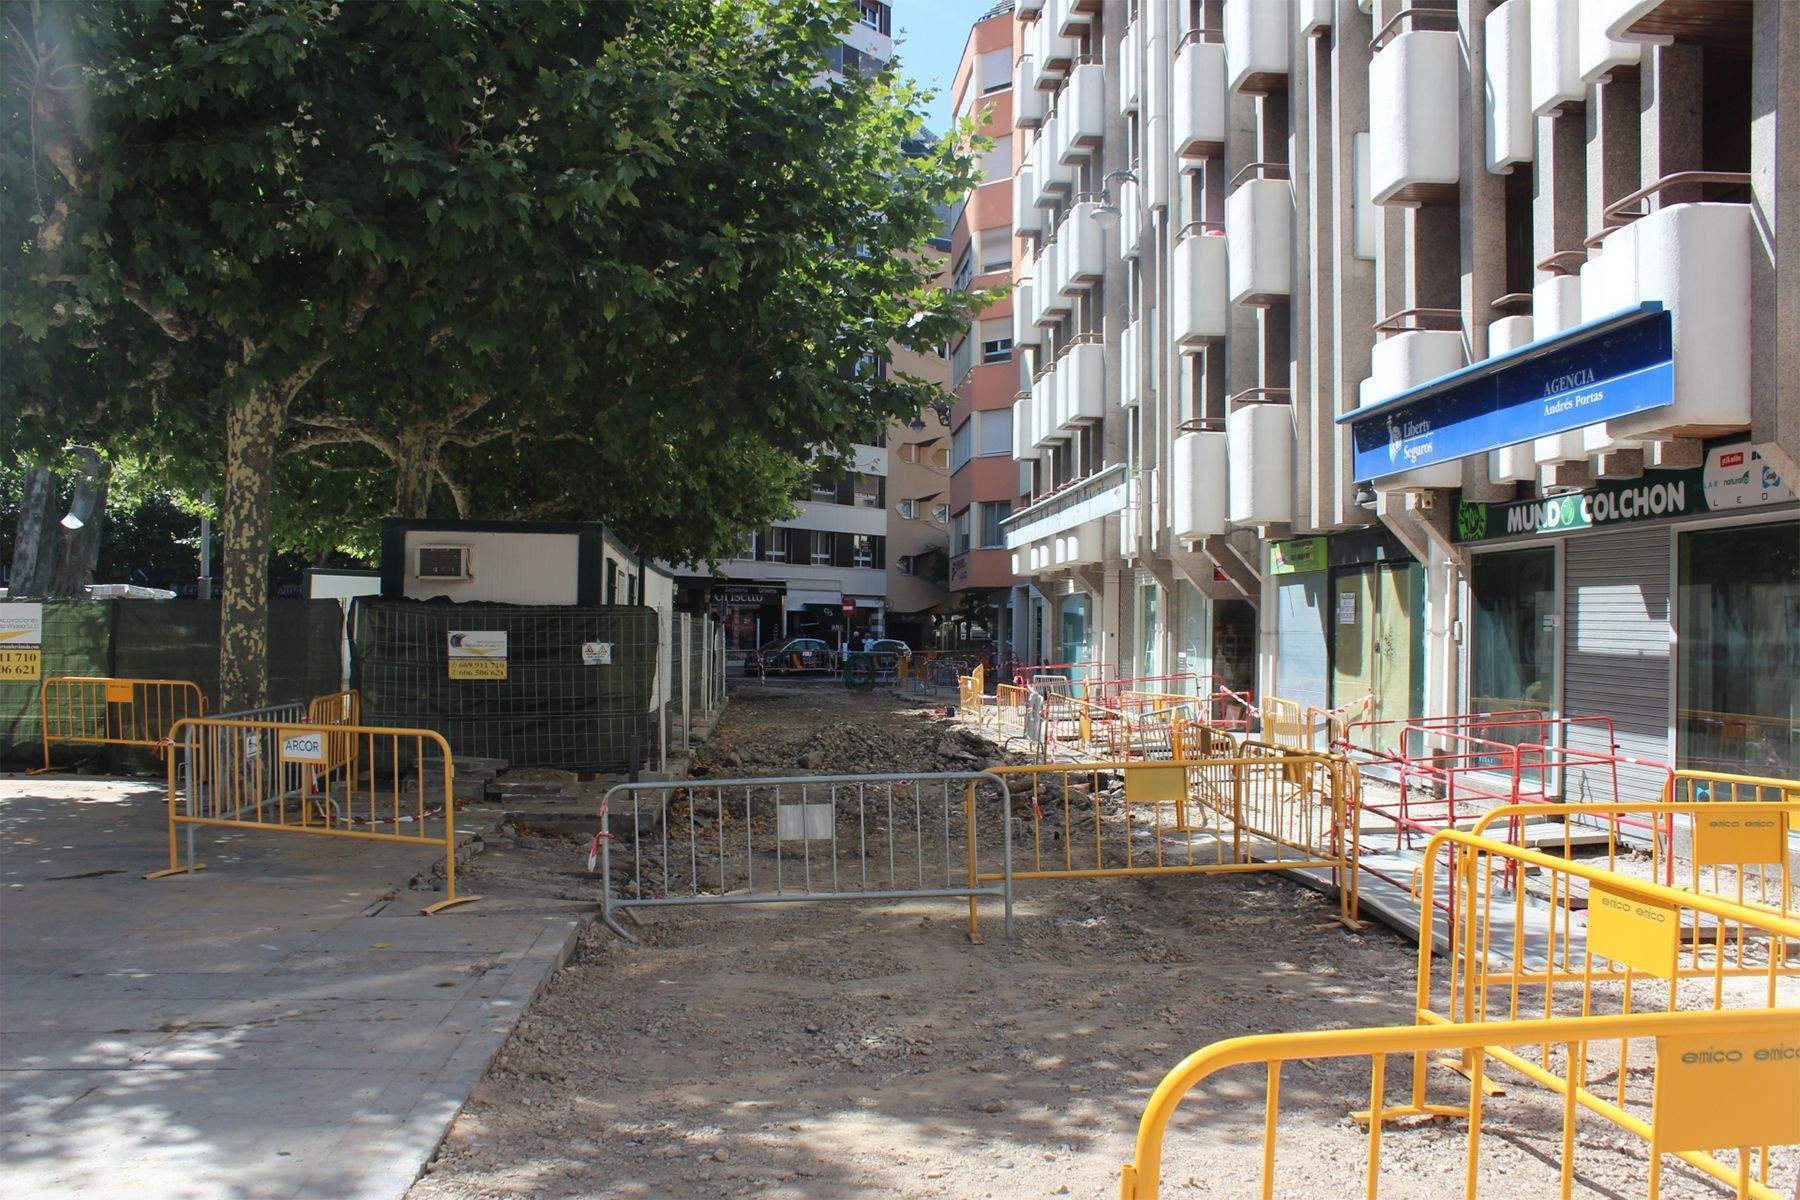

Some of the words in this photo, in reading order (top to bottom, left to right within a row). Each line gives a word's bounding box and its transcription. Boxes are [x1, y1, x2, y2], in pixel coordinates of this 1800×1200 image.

[1544, 368, 1595, 396] AGENCIA
[1544, 398, 1573, 416] Andrés
[1575, 391, 1604, 407] Portas
[1403, 419, 1432, 437] Liberty
[1403, 442, 1433, 463] Seguros
[1508, 496, 1574, 533] MUNDO
[1580, 480, 1685, 522] COLCHON
[15, 653, 37, 662] 710
[15, 665, 35, 674] 621
[285, 740, 319, 752] ARCOR
[1681, 1046, 1743, 1063] emico
